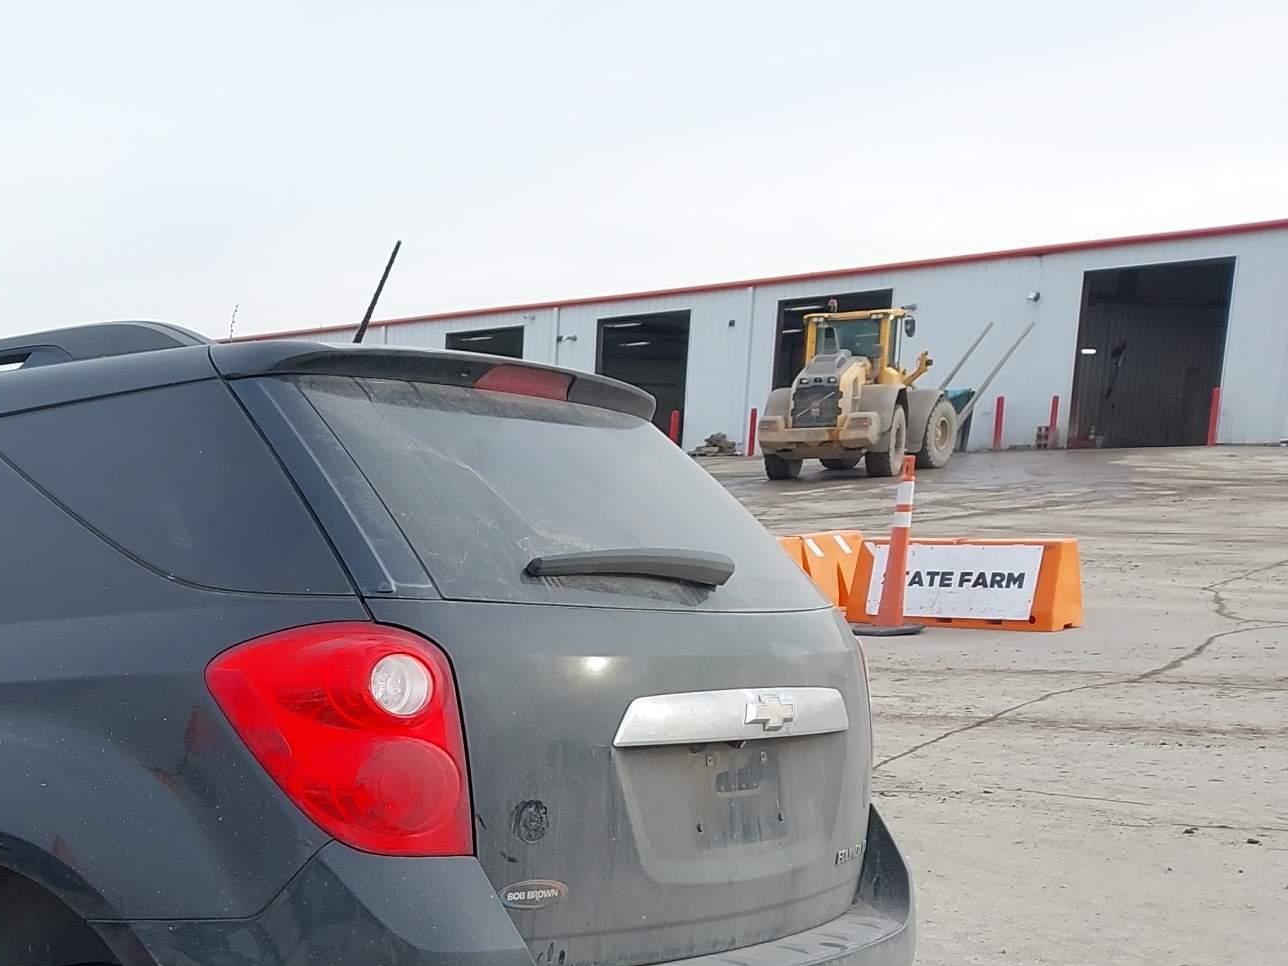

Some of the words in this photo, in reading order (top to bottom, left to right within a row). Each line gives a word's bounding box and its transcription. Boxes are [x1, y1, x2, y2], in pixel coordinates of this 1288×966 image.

[881, 570, 954, 588] ATE
[957, 571, 1026, 589] FARM
[507, 891, 526, 901] BOB
[527, 888, 559, 901] BROWN
